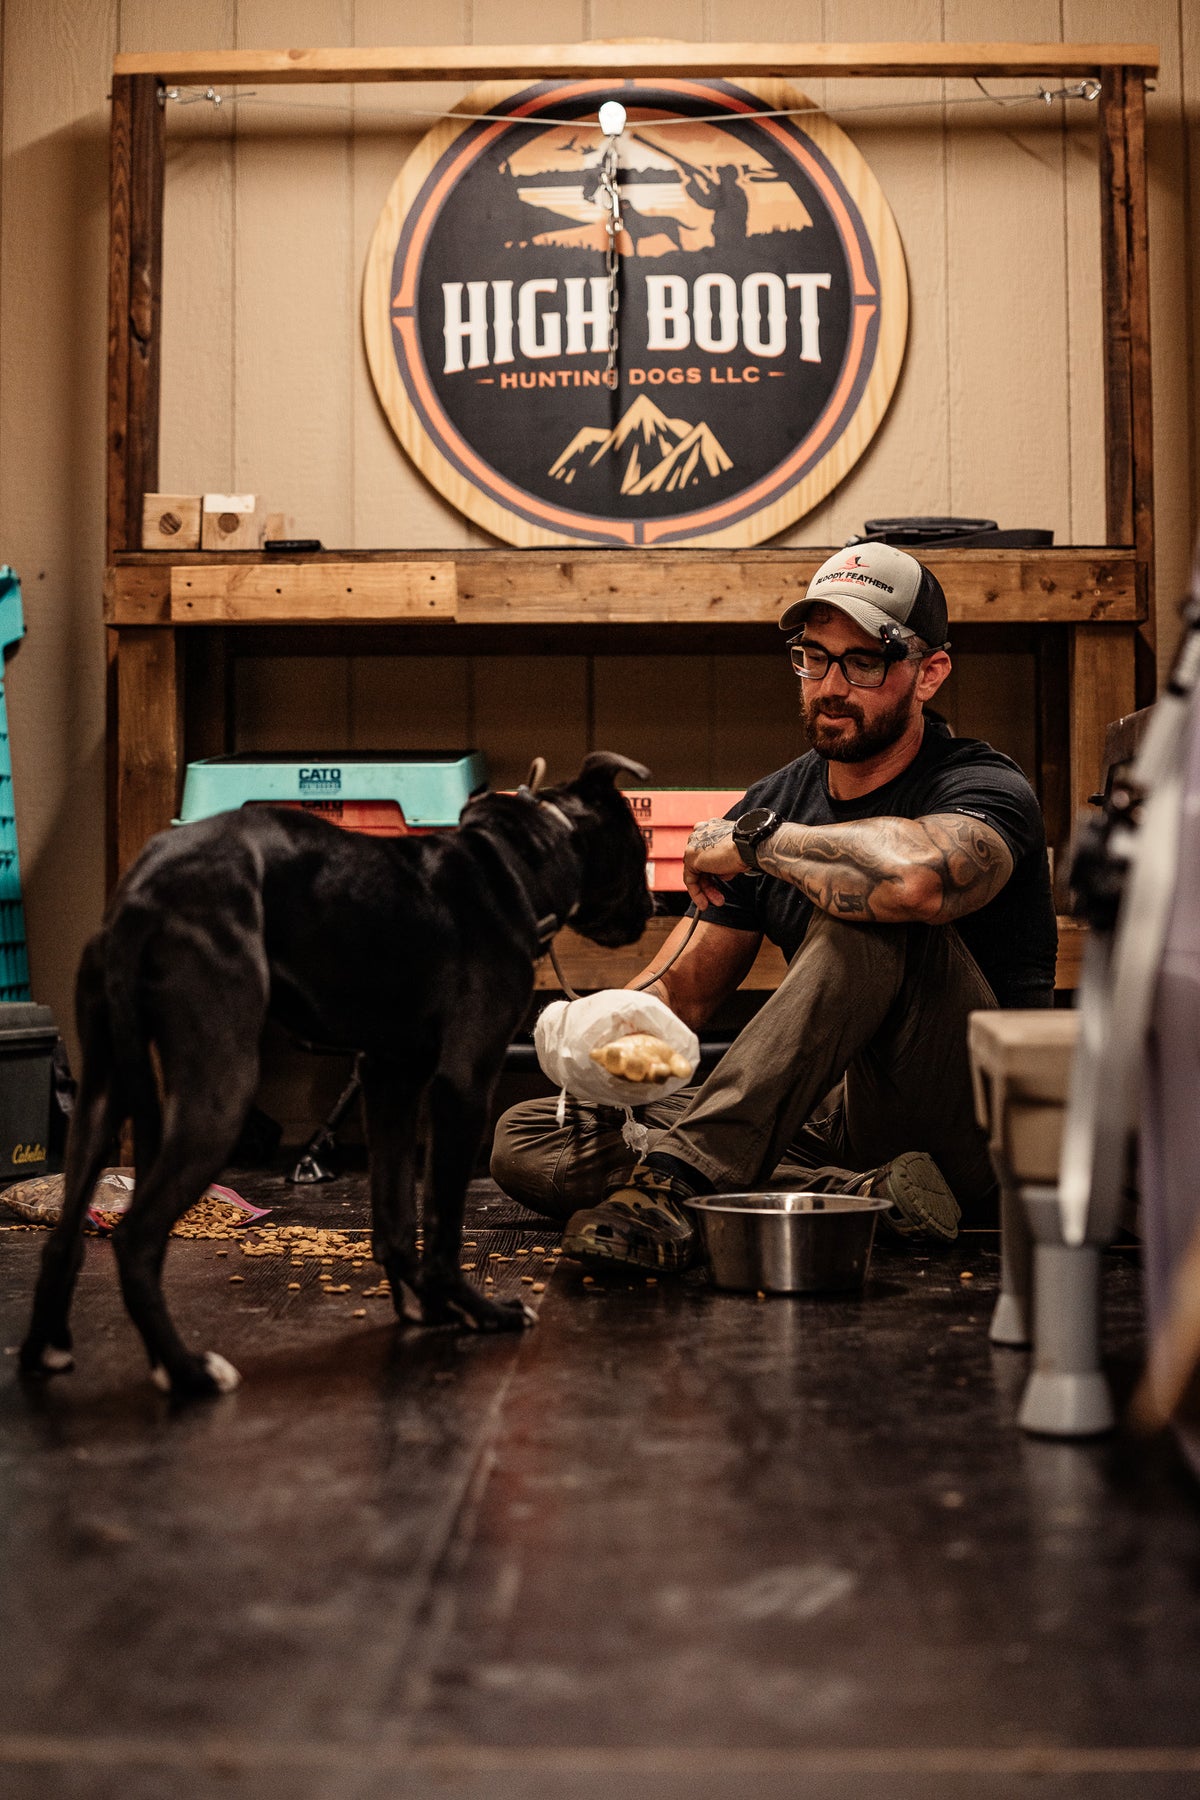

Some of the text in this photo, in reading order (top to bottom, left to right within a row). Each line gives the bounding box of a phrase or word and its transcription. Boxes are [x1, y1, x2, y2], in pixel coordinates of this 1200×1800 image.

[441, 272, 832, 374] HIGH BOOT
[501, 366, 761, 389] HUNTING DOGS LLC
[815, 571, 895, 594] BLOODY FEATHERS
[299, 768, 342, 780] CATO
